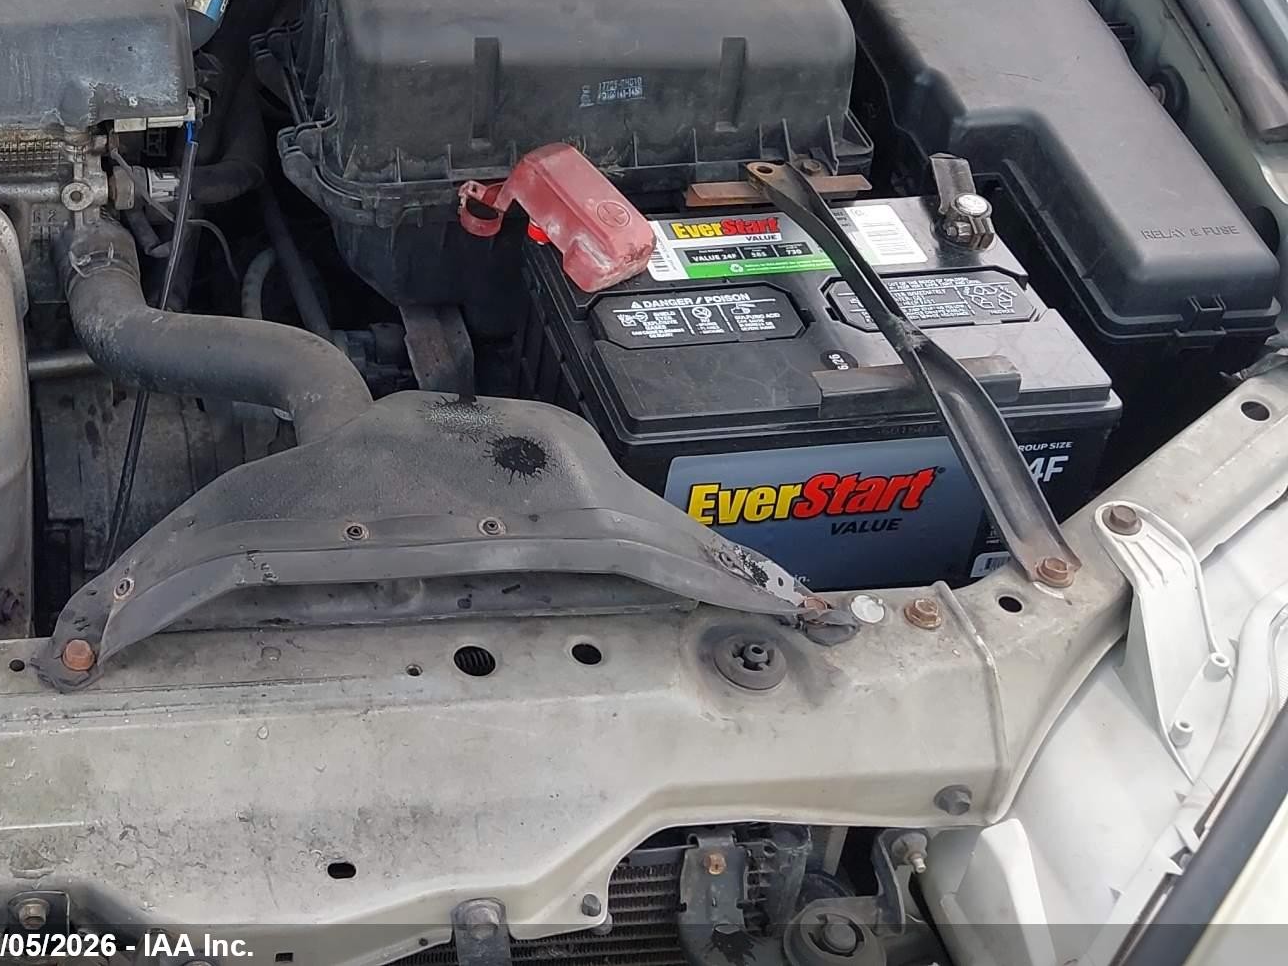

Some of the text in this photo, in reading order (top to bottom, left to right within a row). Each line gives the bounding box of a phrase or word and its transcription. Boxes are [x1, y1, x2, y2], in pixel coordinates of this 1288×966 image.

[671, 217, 780, 239] EverStart
[1140, 227, 1185, 240] RELAY
[1202, 225, 1240, 235] FUSE
[745, 234, 778, 242] VALUE
[692, 254, 720, 262] VALUE
[643, 298, 693, 309] DANGER
[706, 293, 750, 303] POISON
[1018, 441, 1074, 452] ROUP SIZE
[1027, 455, 1069, 482] 4F
[686, 466, 939, 526] EverStart
[831, 518, 902, 535] VALUE
